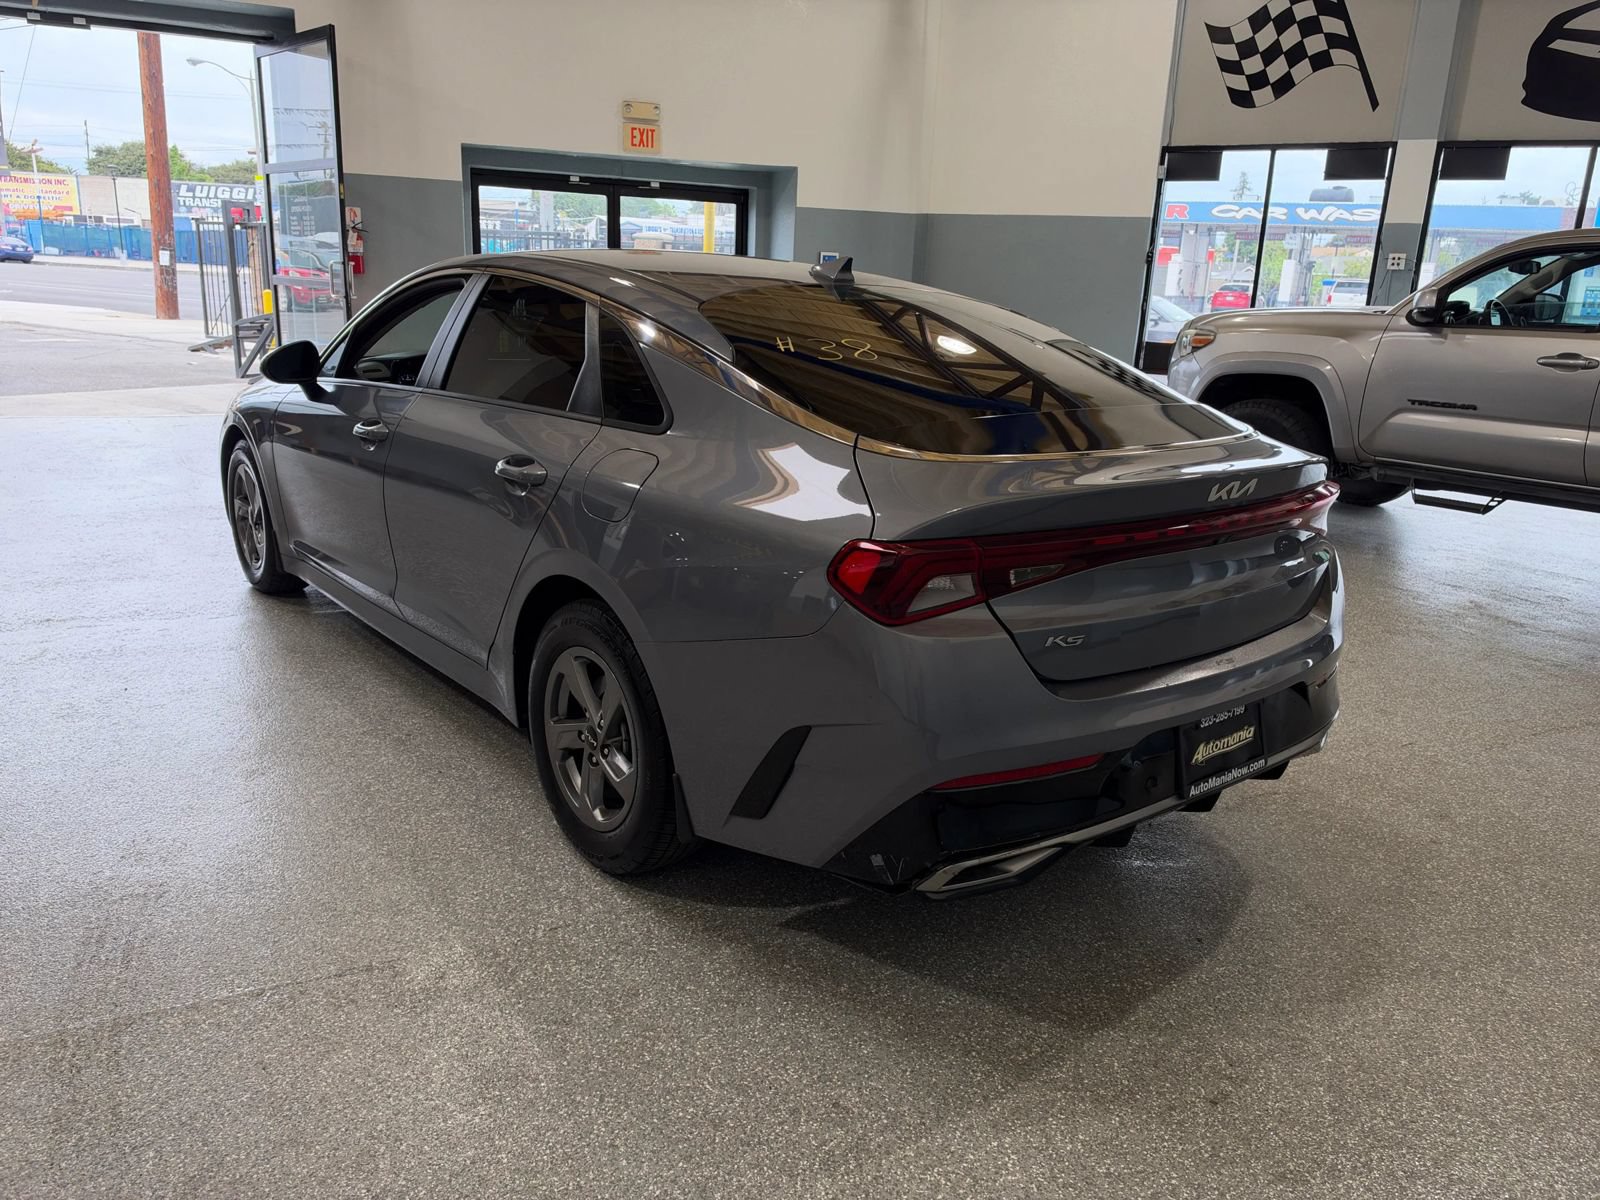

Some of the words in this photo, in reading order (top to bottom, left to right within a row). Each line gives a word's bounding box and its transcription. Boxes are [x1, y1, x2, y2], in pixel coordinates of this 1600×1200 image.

[630, 127, 656, 149] EXIT
[0, 176, 53, 185] TRANSMISION
[54, 178, 69, 187] INC.
[178, 184, 255, 200] LUIGGI
[1211, 204, 1288, 220] CAR
[776, 336, 795, 353] #
[807, 338, 878, 361] 38
[1407, 398, 1477, 411] TACOMA
[1207, 478, 1258, 502] KIA
[1044, 634, 1087, 648] K5
[1191, 725, 1255, 765] Automania
[1189, 759, 1266, 797] AutoManiaNow.com
